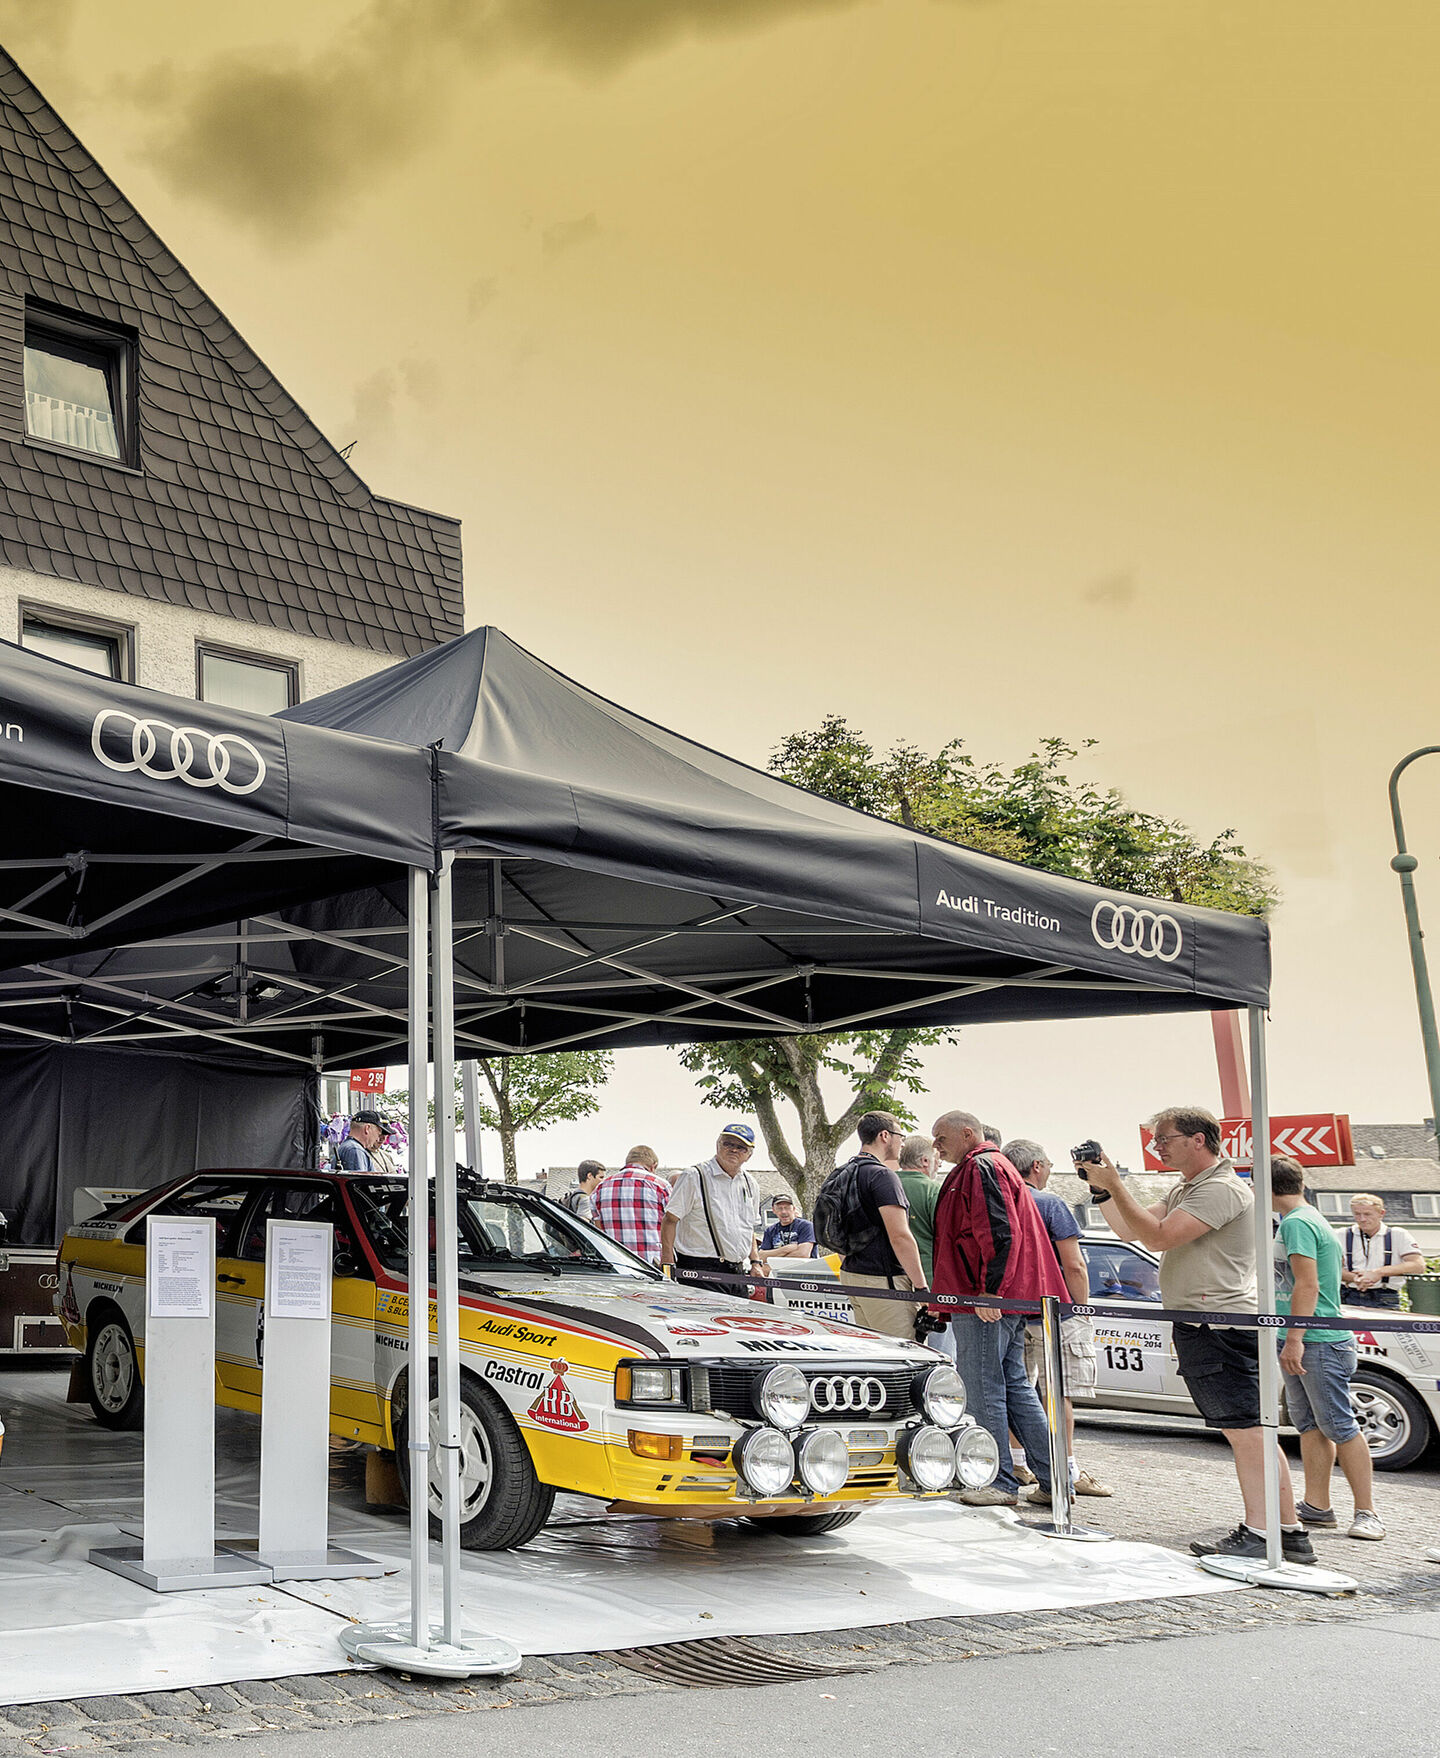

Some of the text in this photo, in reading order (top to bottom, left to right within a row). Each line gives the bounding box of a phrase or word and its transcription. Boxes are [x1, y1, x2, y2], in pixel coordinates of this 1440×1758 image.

[935, 889, 1061, 933] Audi Tradition
[367, 1184, 407, 1194] HB
[788, 1300, 854, 1311] MICHELIN
[478, 1320, 558, 1347] Audi Sport
[1095, 1328, 1162, 1341] EIFEL RALLYE
[375, 1334, 410, 1351] MICHELI
[1093, 1336, 1162, 1349] FESTIVAL 2014
[1104, 1345, 1144, 1372] 133
[484, 1360, 545, 1390] Castrol
[543, 1387, 575, 1418] HB
[534, 1413, 581, 1430] international
